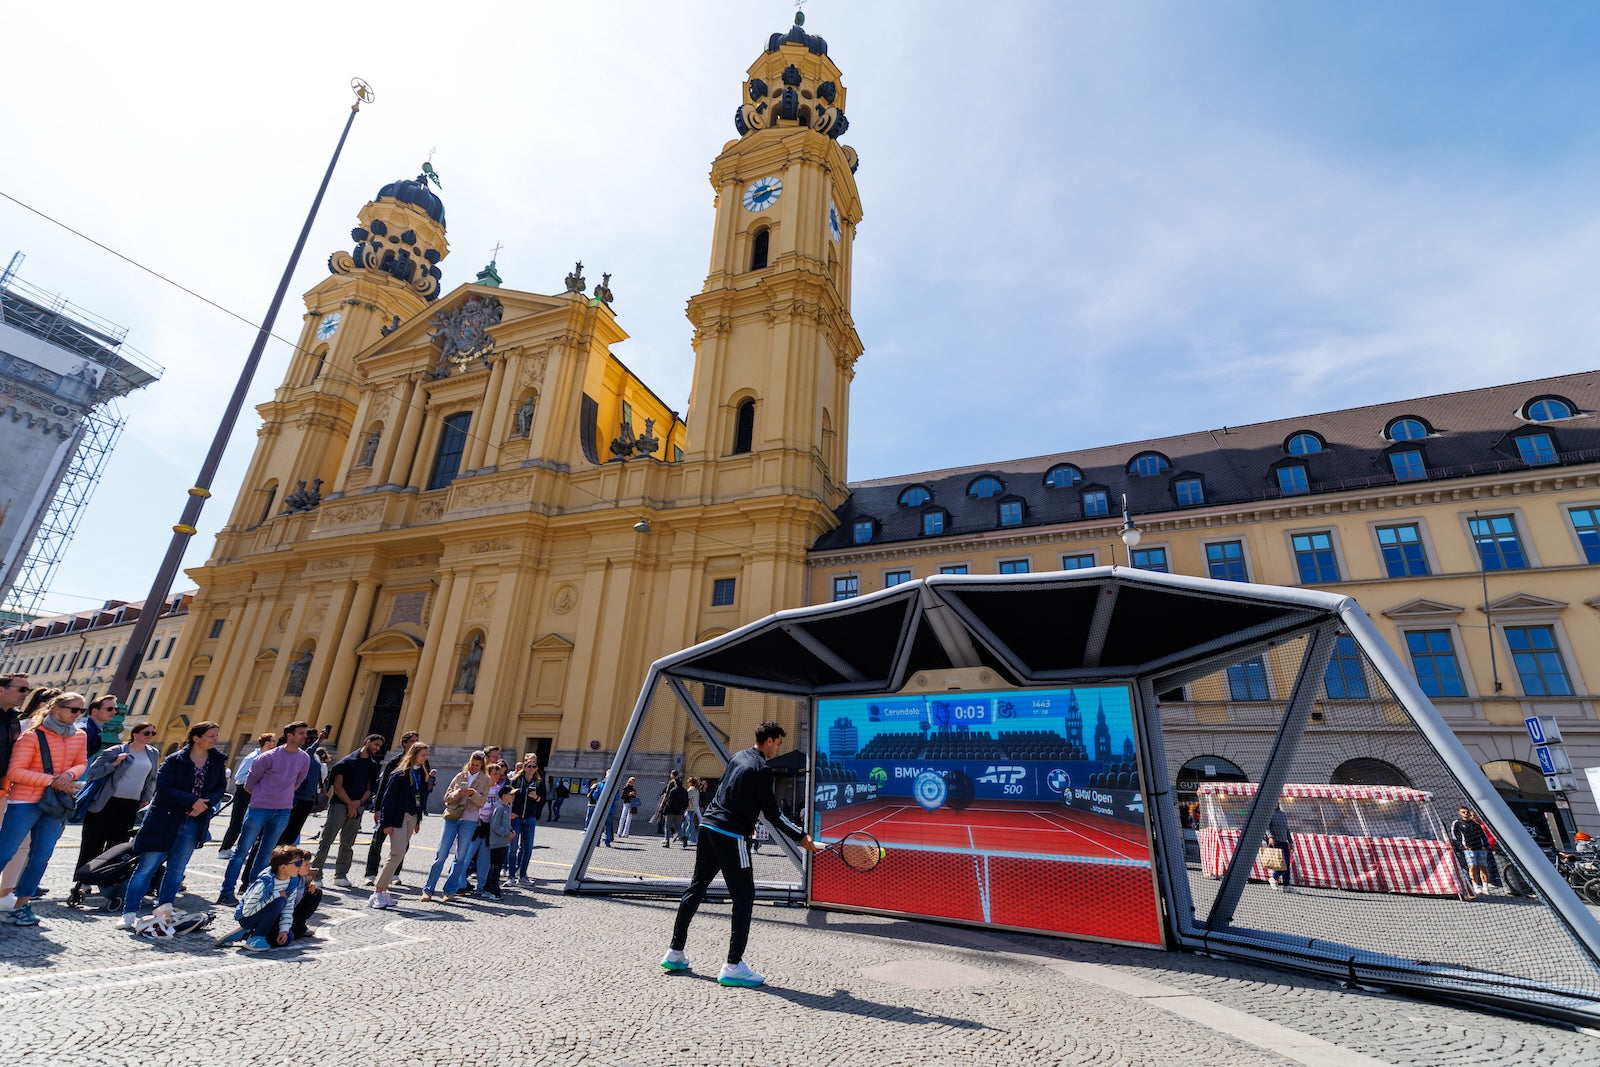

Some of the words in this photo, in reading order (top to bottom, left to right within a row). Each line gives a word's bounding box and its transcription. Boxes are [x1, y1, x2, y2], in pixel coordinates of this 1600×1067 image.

[1032, 699, 1051, 708] 1443
[884, 707, 920, 716] Cerundolo
[954, 705, 985, 719] 0:03
[1528, 721, 1541, 740] U
[894, 767, 924, 778] BMW
[976, 766, 1027, 784] ATP
[815, 784, 838, 802] ATP
[1003, 784, 1024, 795] 500
[1074, 789, 1091, 801] BMW
[1091, 790, 1113, 804] Open
[826, 800, 837, 810] 500
